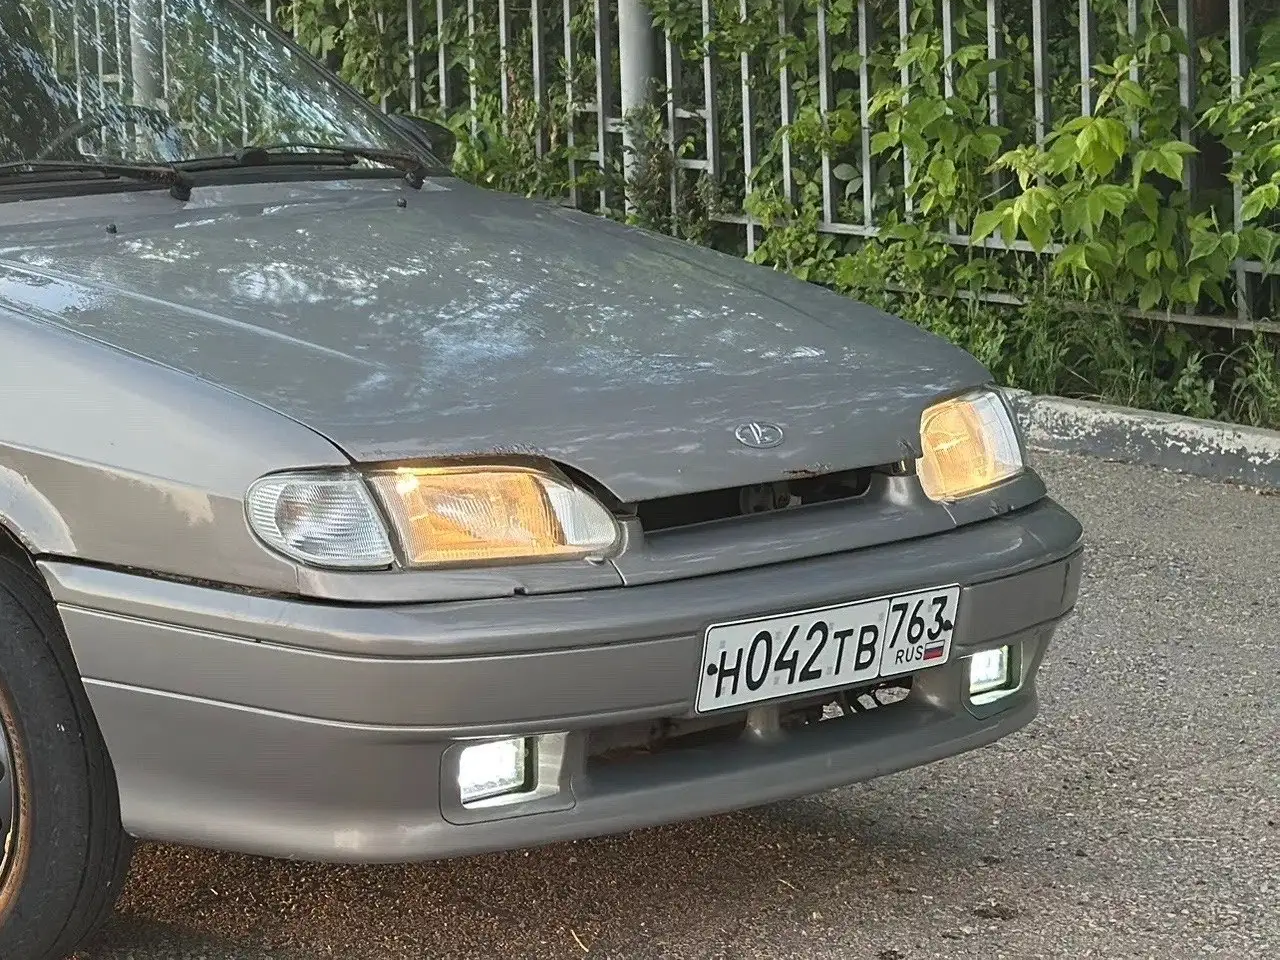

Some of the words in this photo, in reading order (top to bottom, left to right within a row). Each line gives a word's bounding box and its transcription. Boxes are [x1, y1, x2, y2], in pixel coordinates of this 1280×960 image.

[715, 621, 879, 698] Н042ТВ
[888, 595, 948, 648] 763
[895, 645, 923, 665] RUS
